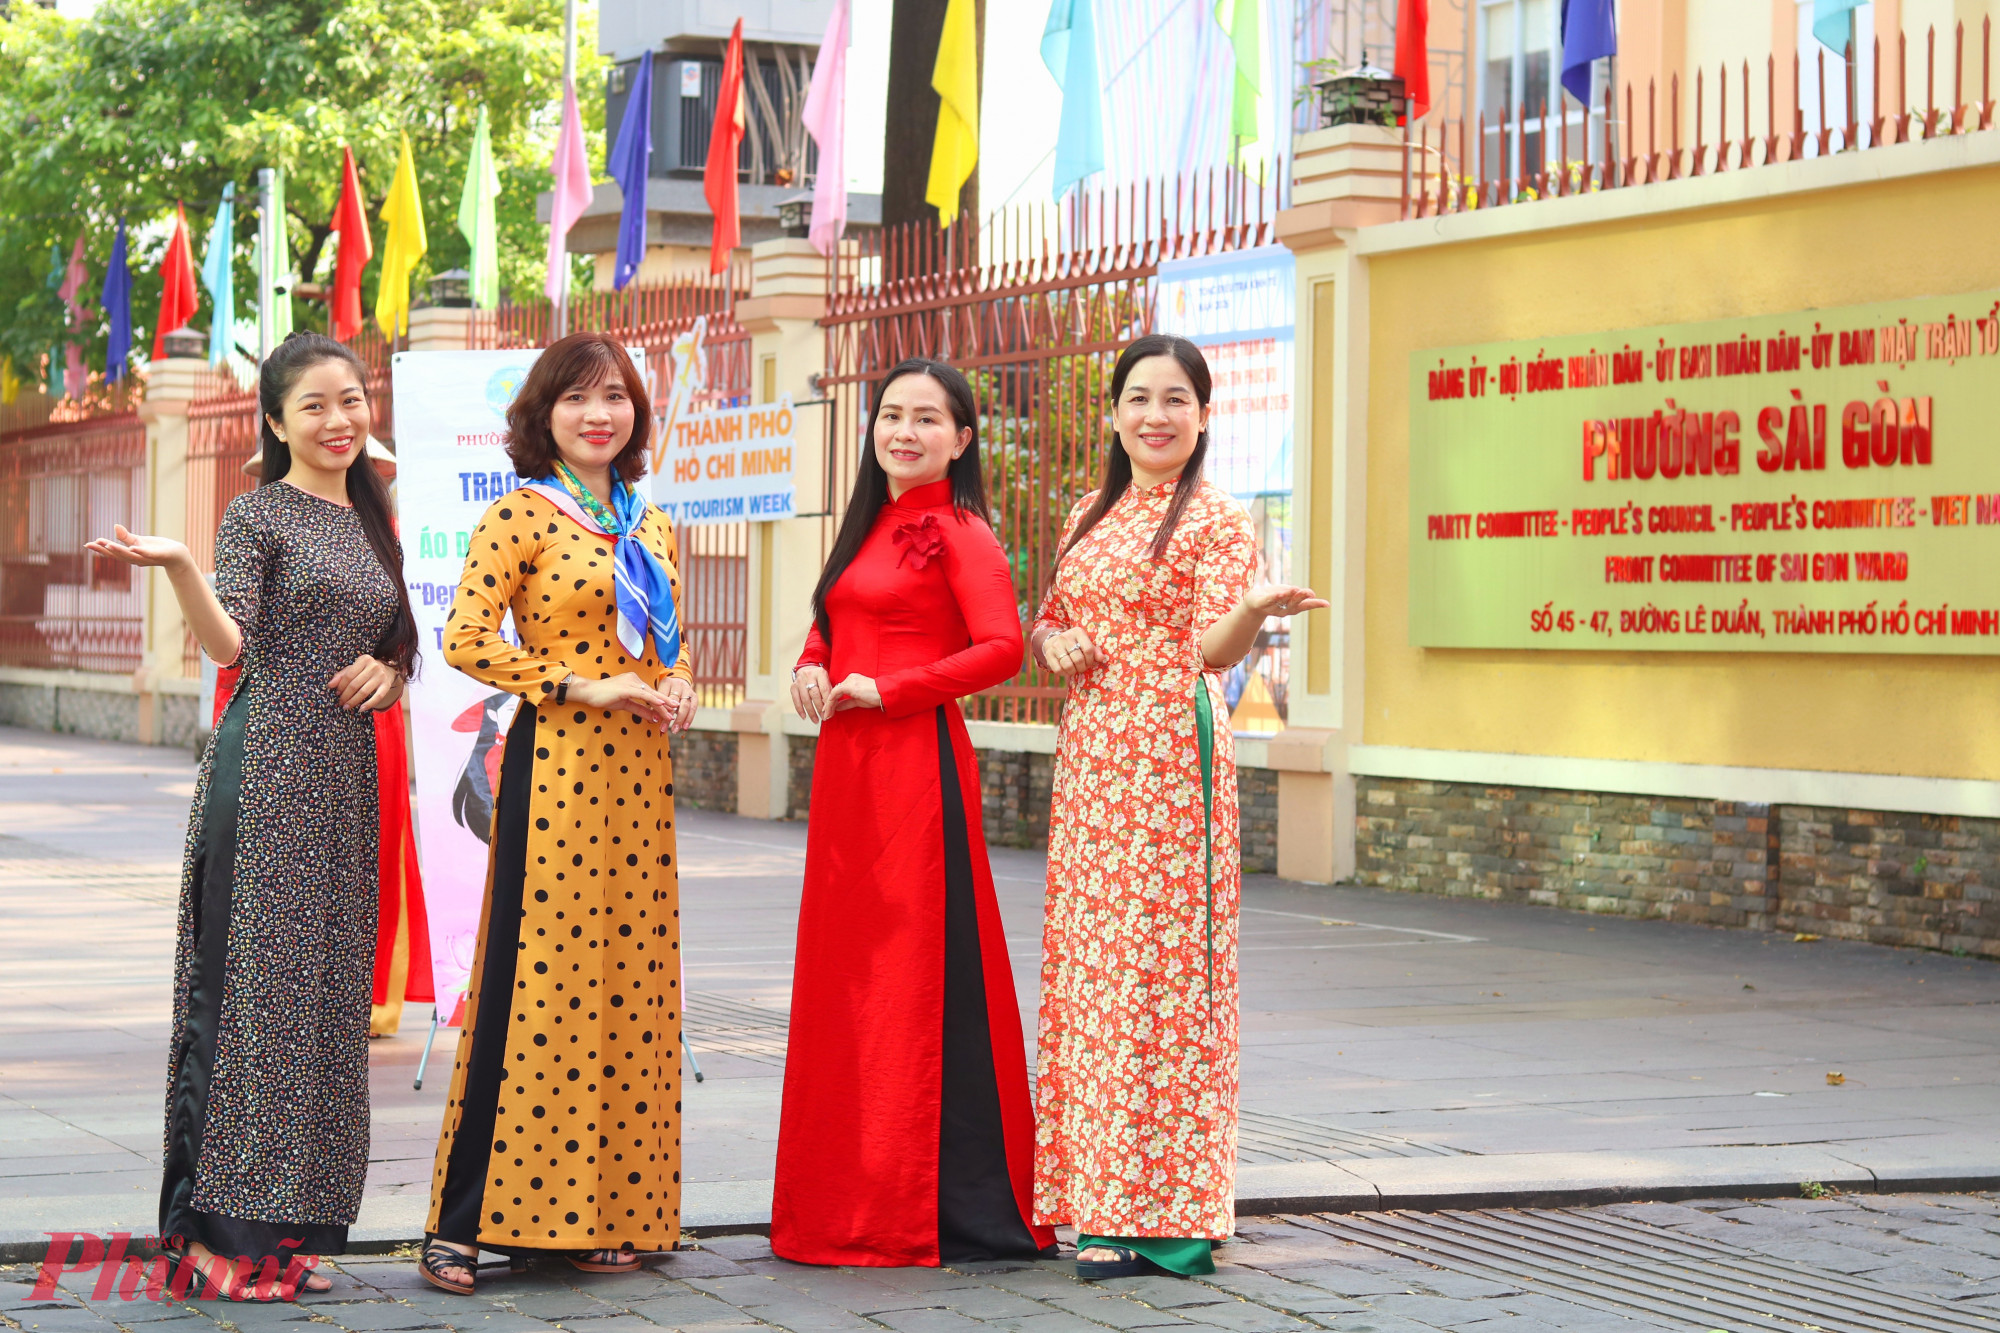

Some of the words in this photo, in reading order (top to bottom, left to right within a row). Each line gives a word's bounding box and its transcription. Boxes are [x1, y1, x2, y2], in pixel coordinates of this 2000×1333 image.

[1428, 358, 1465, 400] ĐẢNG
[1469, 356, 1487, 398] ỦY
[1499, 356, 1522, 401] HỘI
[1568, 348, 1609, 389] NHÂN
[1612, 344, 1643, 385] DÂN
[1656, 338, 1676, 382] ỦY
[1680, 344, 1712, 380] BAN
[1716, 333, 1761, 377] NHÂN
[1766, 330, 1800, 373] DÂN
[1811, 321, 1834, 369] ỦY
[1839, 328, 1875, 366] BAN
[1880, 318, 1918, 370] MẶT
[1922, 313, 1971, 366] TRẬN
[1976, 300, 2000, 356] TỔ
[457, 432, 507, 446] PHƯỜ
[676, 414, 742, 448] THÀNH
[749, 398, 792, 439] PHỐ
[1583, 398, 1740, 481] PHƯỜNG
[1756, 389, 1826, 472] SÀI
[1842, 380, 1932, 468] GÒN
[674, 448, 700, 483] HỒ
[706, 448, 735, 480] CHÍ
[741, 447, 792, 476] MINH
[683, 497, 744, 519] TOURISM
[749, 492, 791, 514] WEEK
[1428, 513, 1472, 540] PARTY
[1476, 510, 1558, 539] COMMITTEE
[1572, 500, 1643, 536] PEOPLE'S
[1648, 505, 1715, 534] COUNCIL
[1731, 494, 1808, 531] PEOPLE'S
[1812, 497, 1915, 530] COMMITTEE
[1931, 495, 1971, 526] VIET
[1976, 494, 2000, 525] NA
[420, 525, 448, 558] ÁO
[1605, 556, 1655, 583] FRONT
[1659, 554, 1752, 583] COMMITTEE
[1756, 554, 1777, 582] OF
[1780, 553, 1808, 582] SAI
[1812, 553, 1849, 582] GON
[1854, 552, 1908, 582] WARD
[1531, 601, 1554, 632] SỐ
[1556, 610, 1574, 632] 45
[1590, 610, 1612, 638] 47,
[1620, 602, 1680, 634] ĐƯỜNG
[1685, 604, 1706, 633] LÊ
[1772, 603, 1834, 635] THÀNH
[1839, 600, 1878, 635] PHỐ
[1881, 598, 1910, 635] HỒ
[1914, 603, 1948, 635] CHÍ
[1951, 610, 2000, 636] MINH
